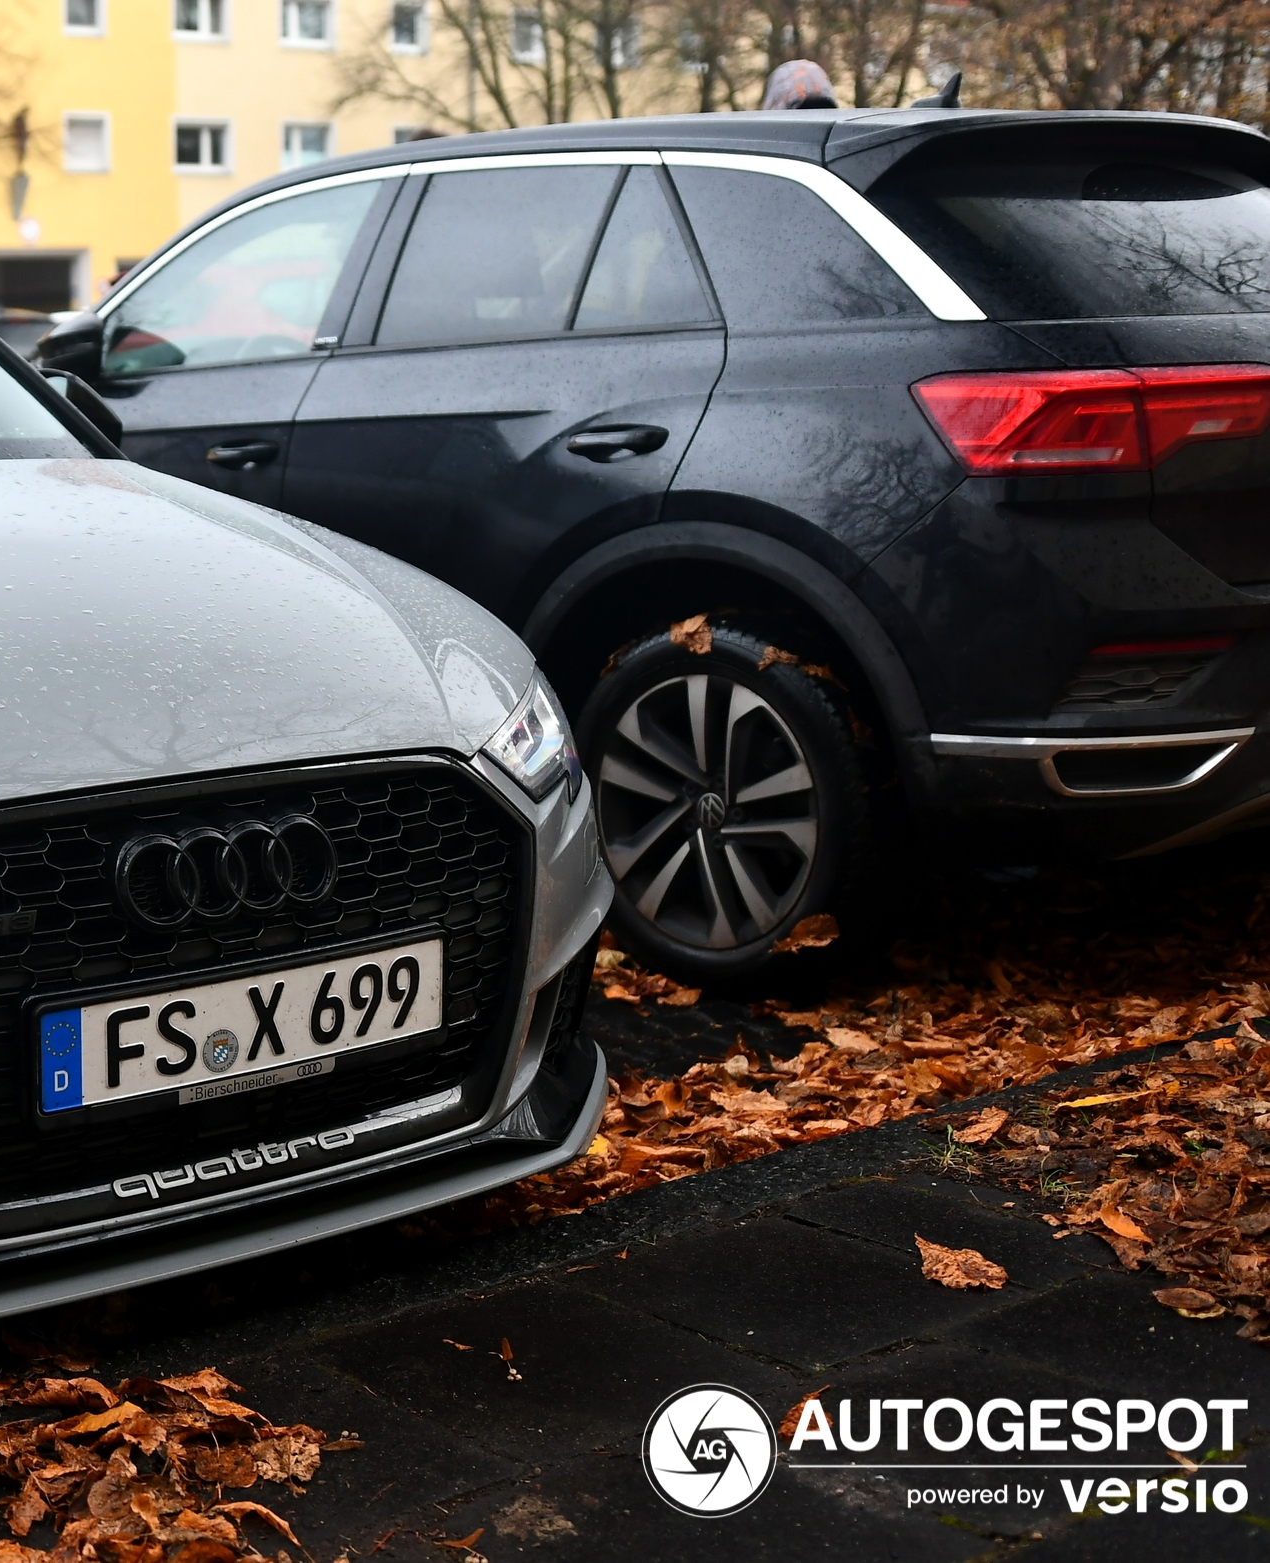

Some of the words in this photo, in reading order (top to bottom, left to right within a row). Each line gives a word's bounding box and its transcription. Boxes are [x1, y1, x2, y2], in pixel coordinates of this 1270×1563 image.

[105, 999, 198, 1089] FS
[247, 980, 286, 1061] X
[309, 954, 420, 1045] 699
[54, 1070, 69, 1092] D
[112, 1126, 355, 1199] quattro
